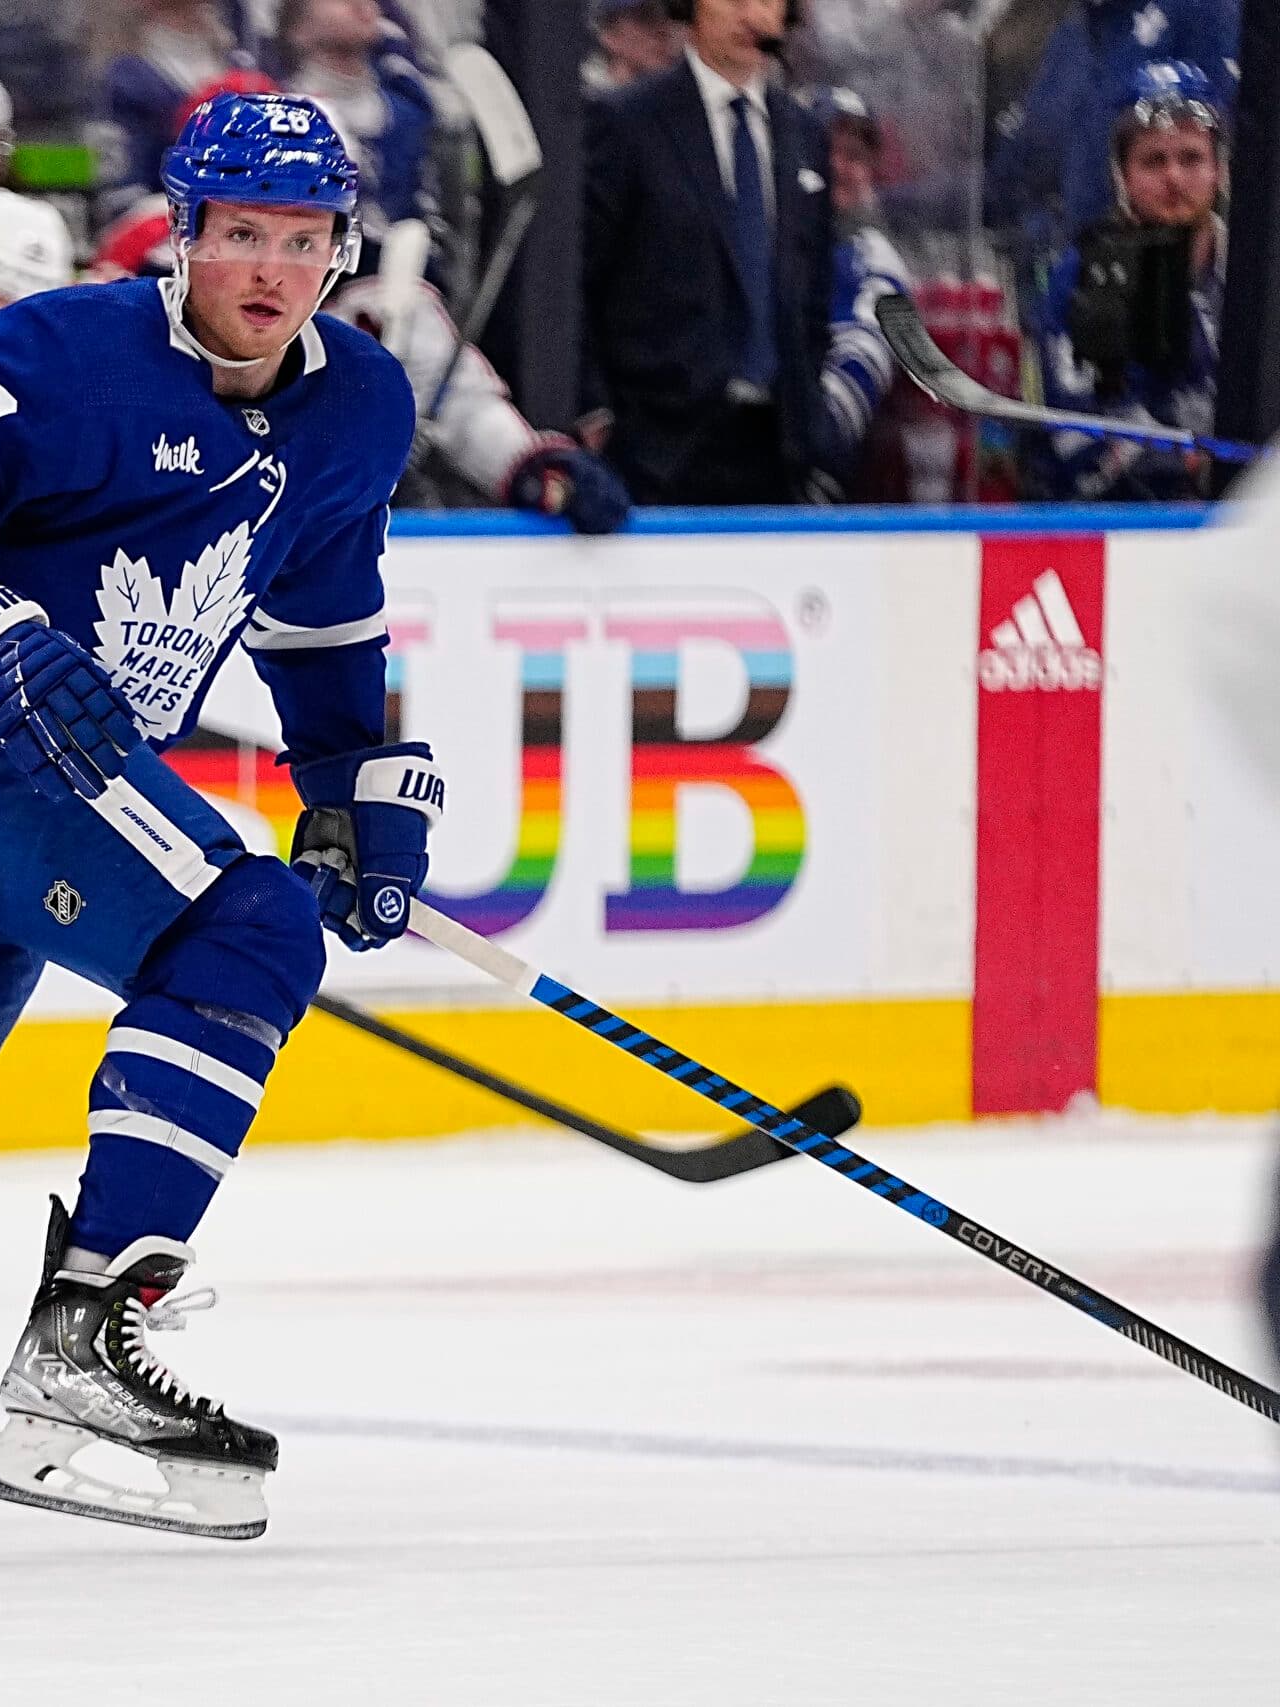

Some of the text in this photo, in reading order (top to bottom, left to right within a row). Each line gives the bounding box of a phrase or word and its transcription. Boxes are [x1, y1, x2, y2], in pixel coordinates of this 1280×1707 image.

[152, 432, 205, 475] Milk
[119, 647, 198, 689] MAPLE
[120, 621, 215, 671] TORONTO
[108, 669, 182, 712] EAFS
[120, 806, 173, 852] WARRIOR
[957, 1221, 1060, 1287] COVERT
